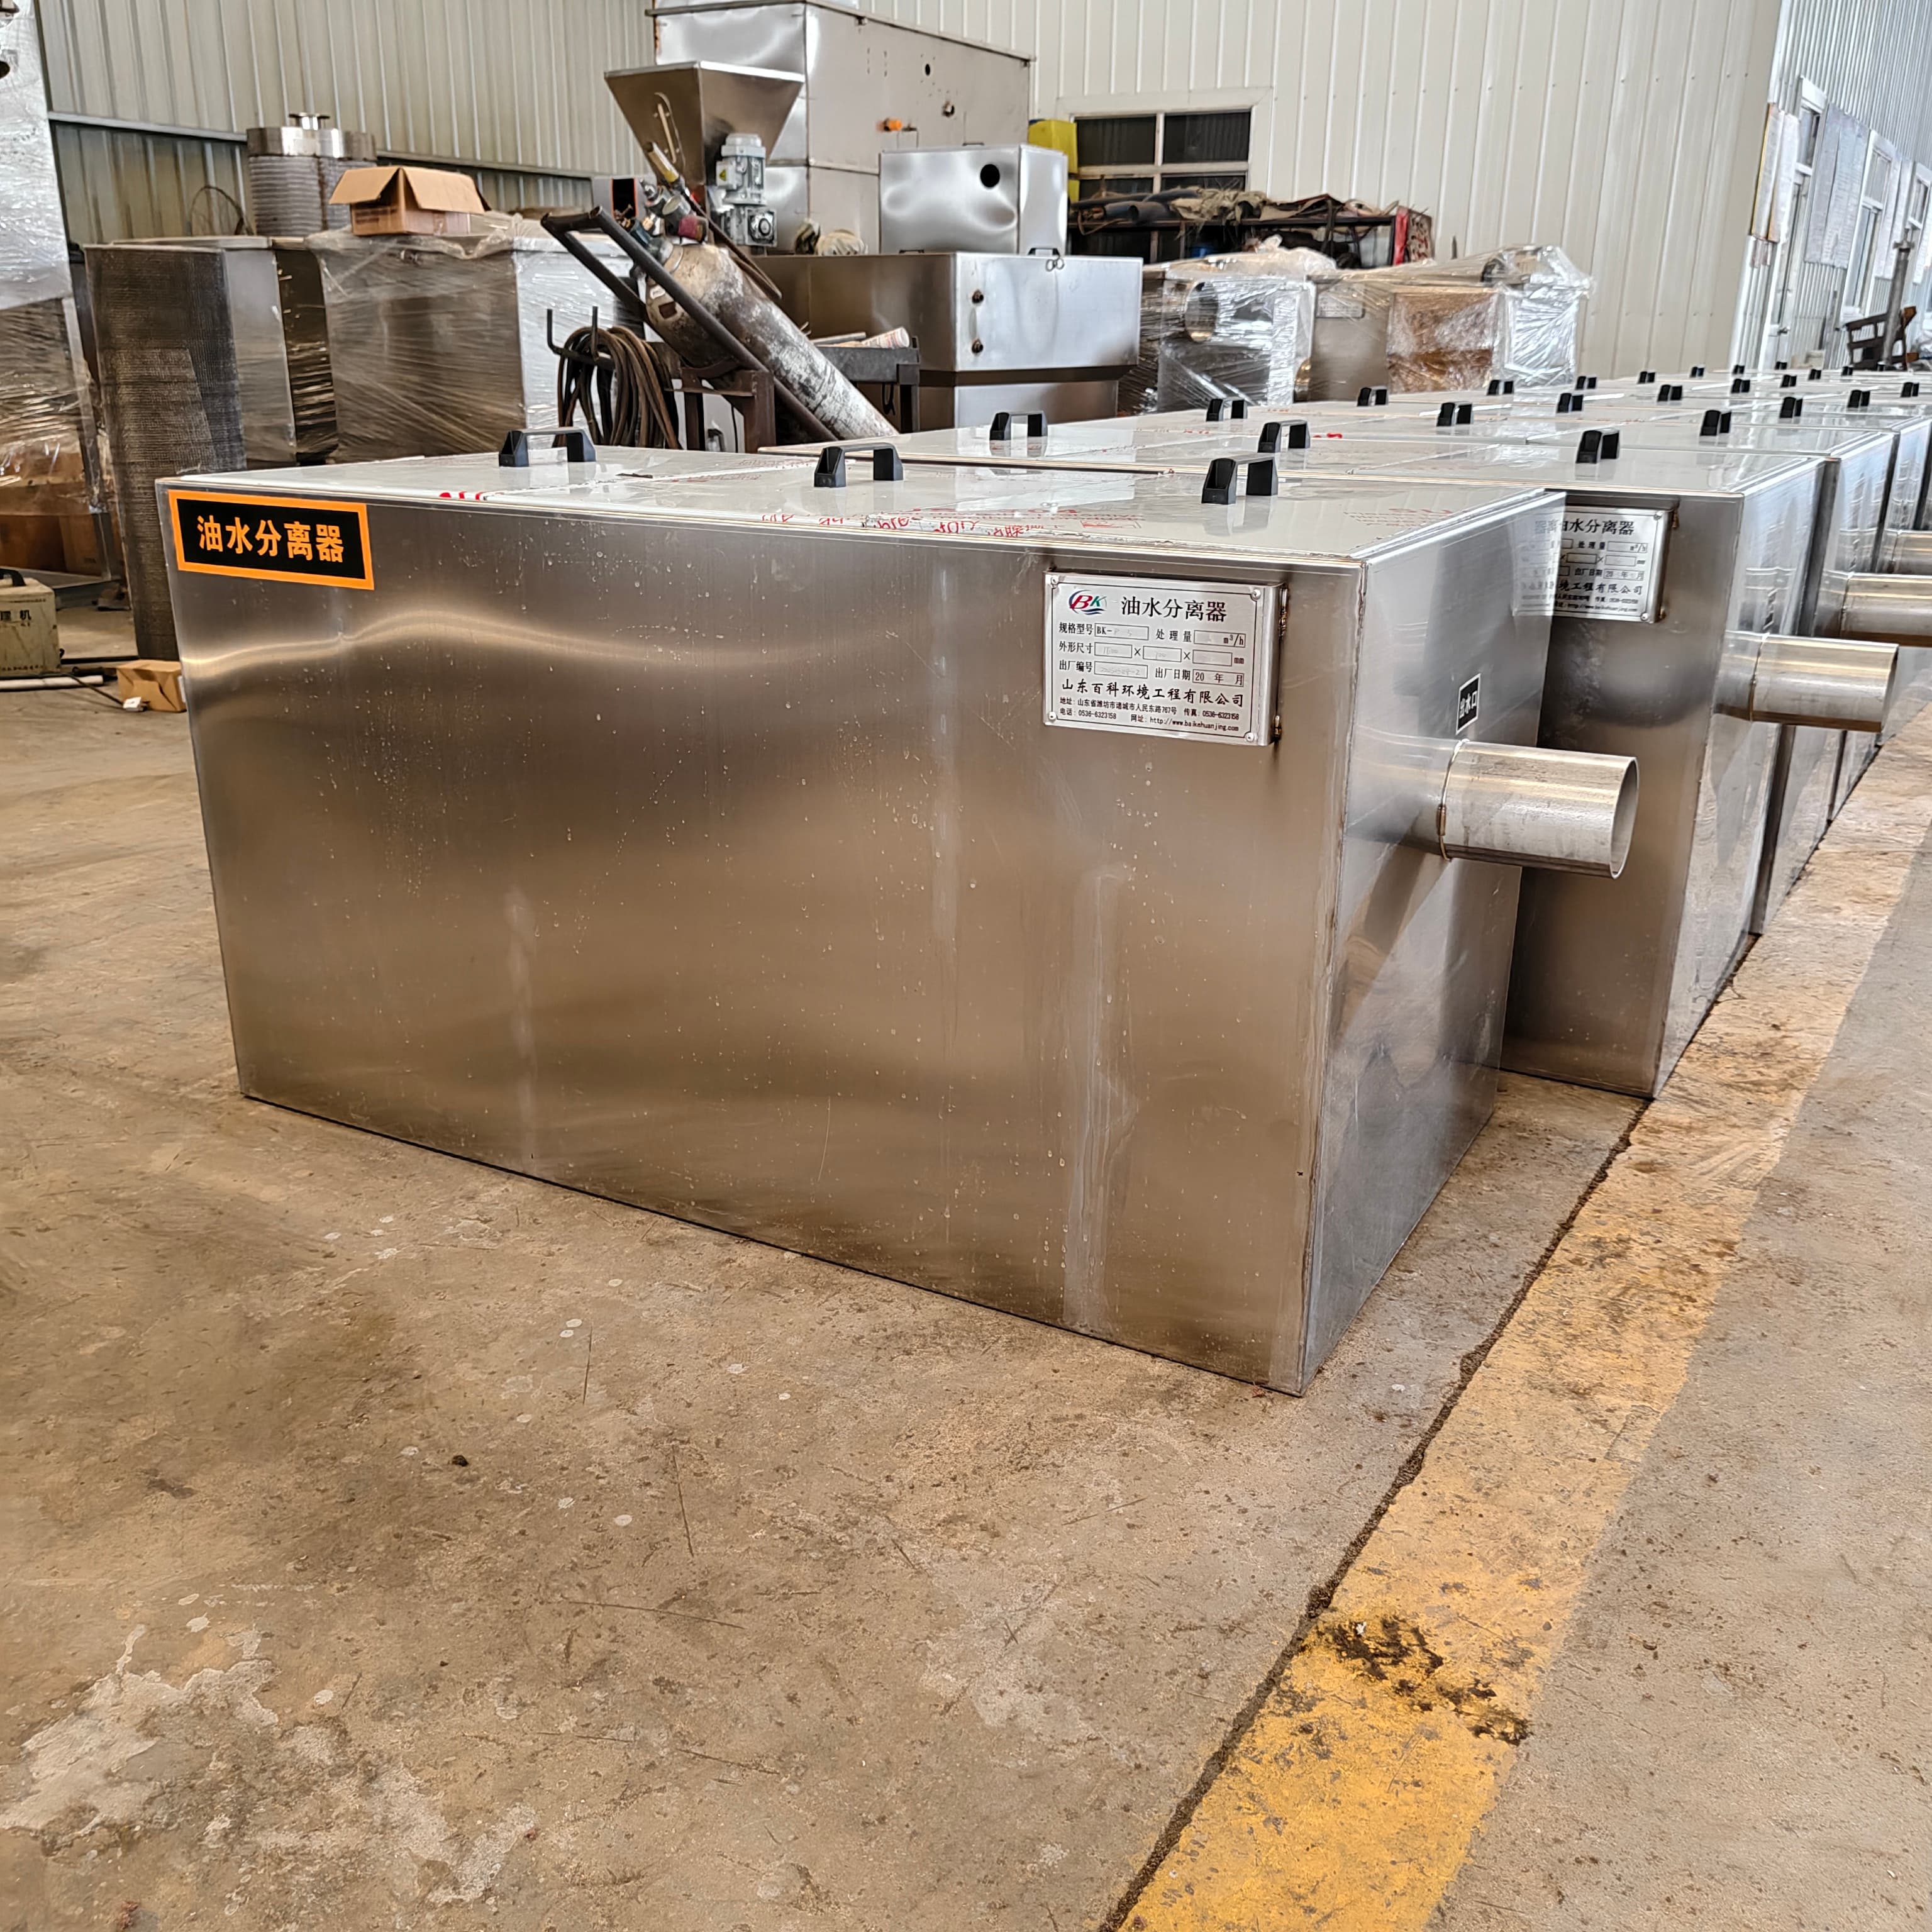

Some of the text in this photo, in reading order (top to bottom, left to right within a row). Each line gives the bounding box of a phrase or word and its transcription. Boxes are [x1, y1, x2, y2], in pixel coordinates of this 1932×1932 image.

[197, 514, 344, 563] 油水分离器
[1121, 596, 1227, 622] 油水分离器
[1059, 622, 1094, 635] 规格型号
[1059, 641, 1094, 654] 外形尺寸
[1059, 660, 1094, 672] 出厂编号
[1155, 667, 1191, 680] 出厂日期
[1062, 679, 1243, 708] 山东百科环境工程有限公司
